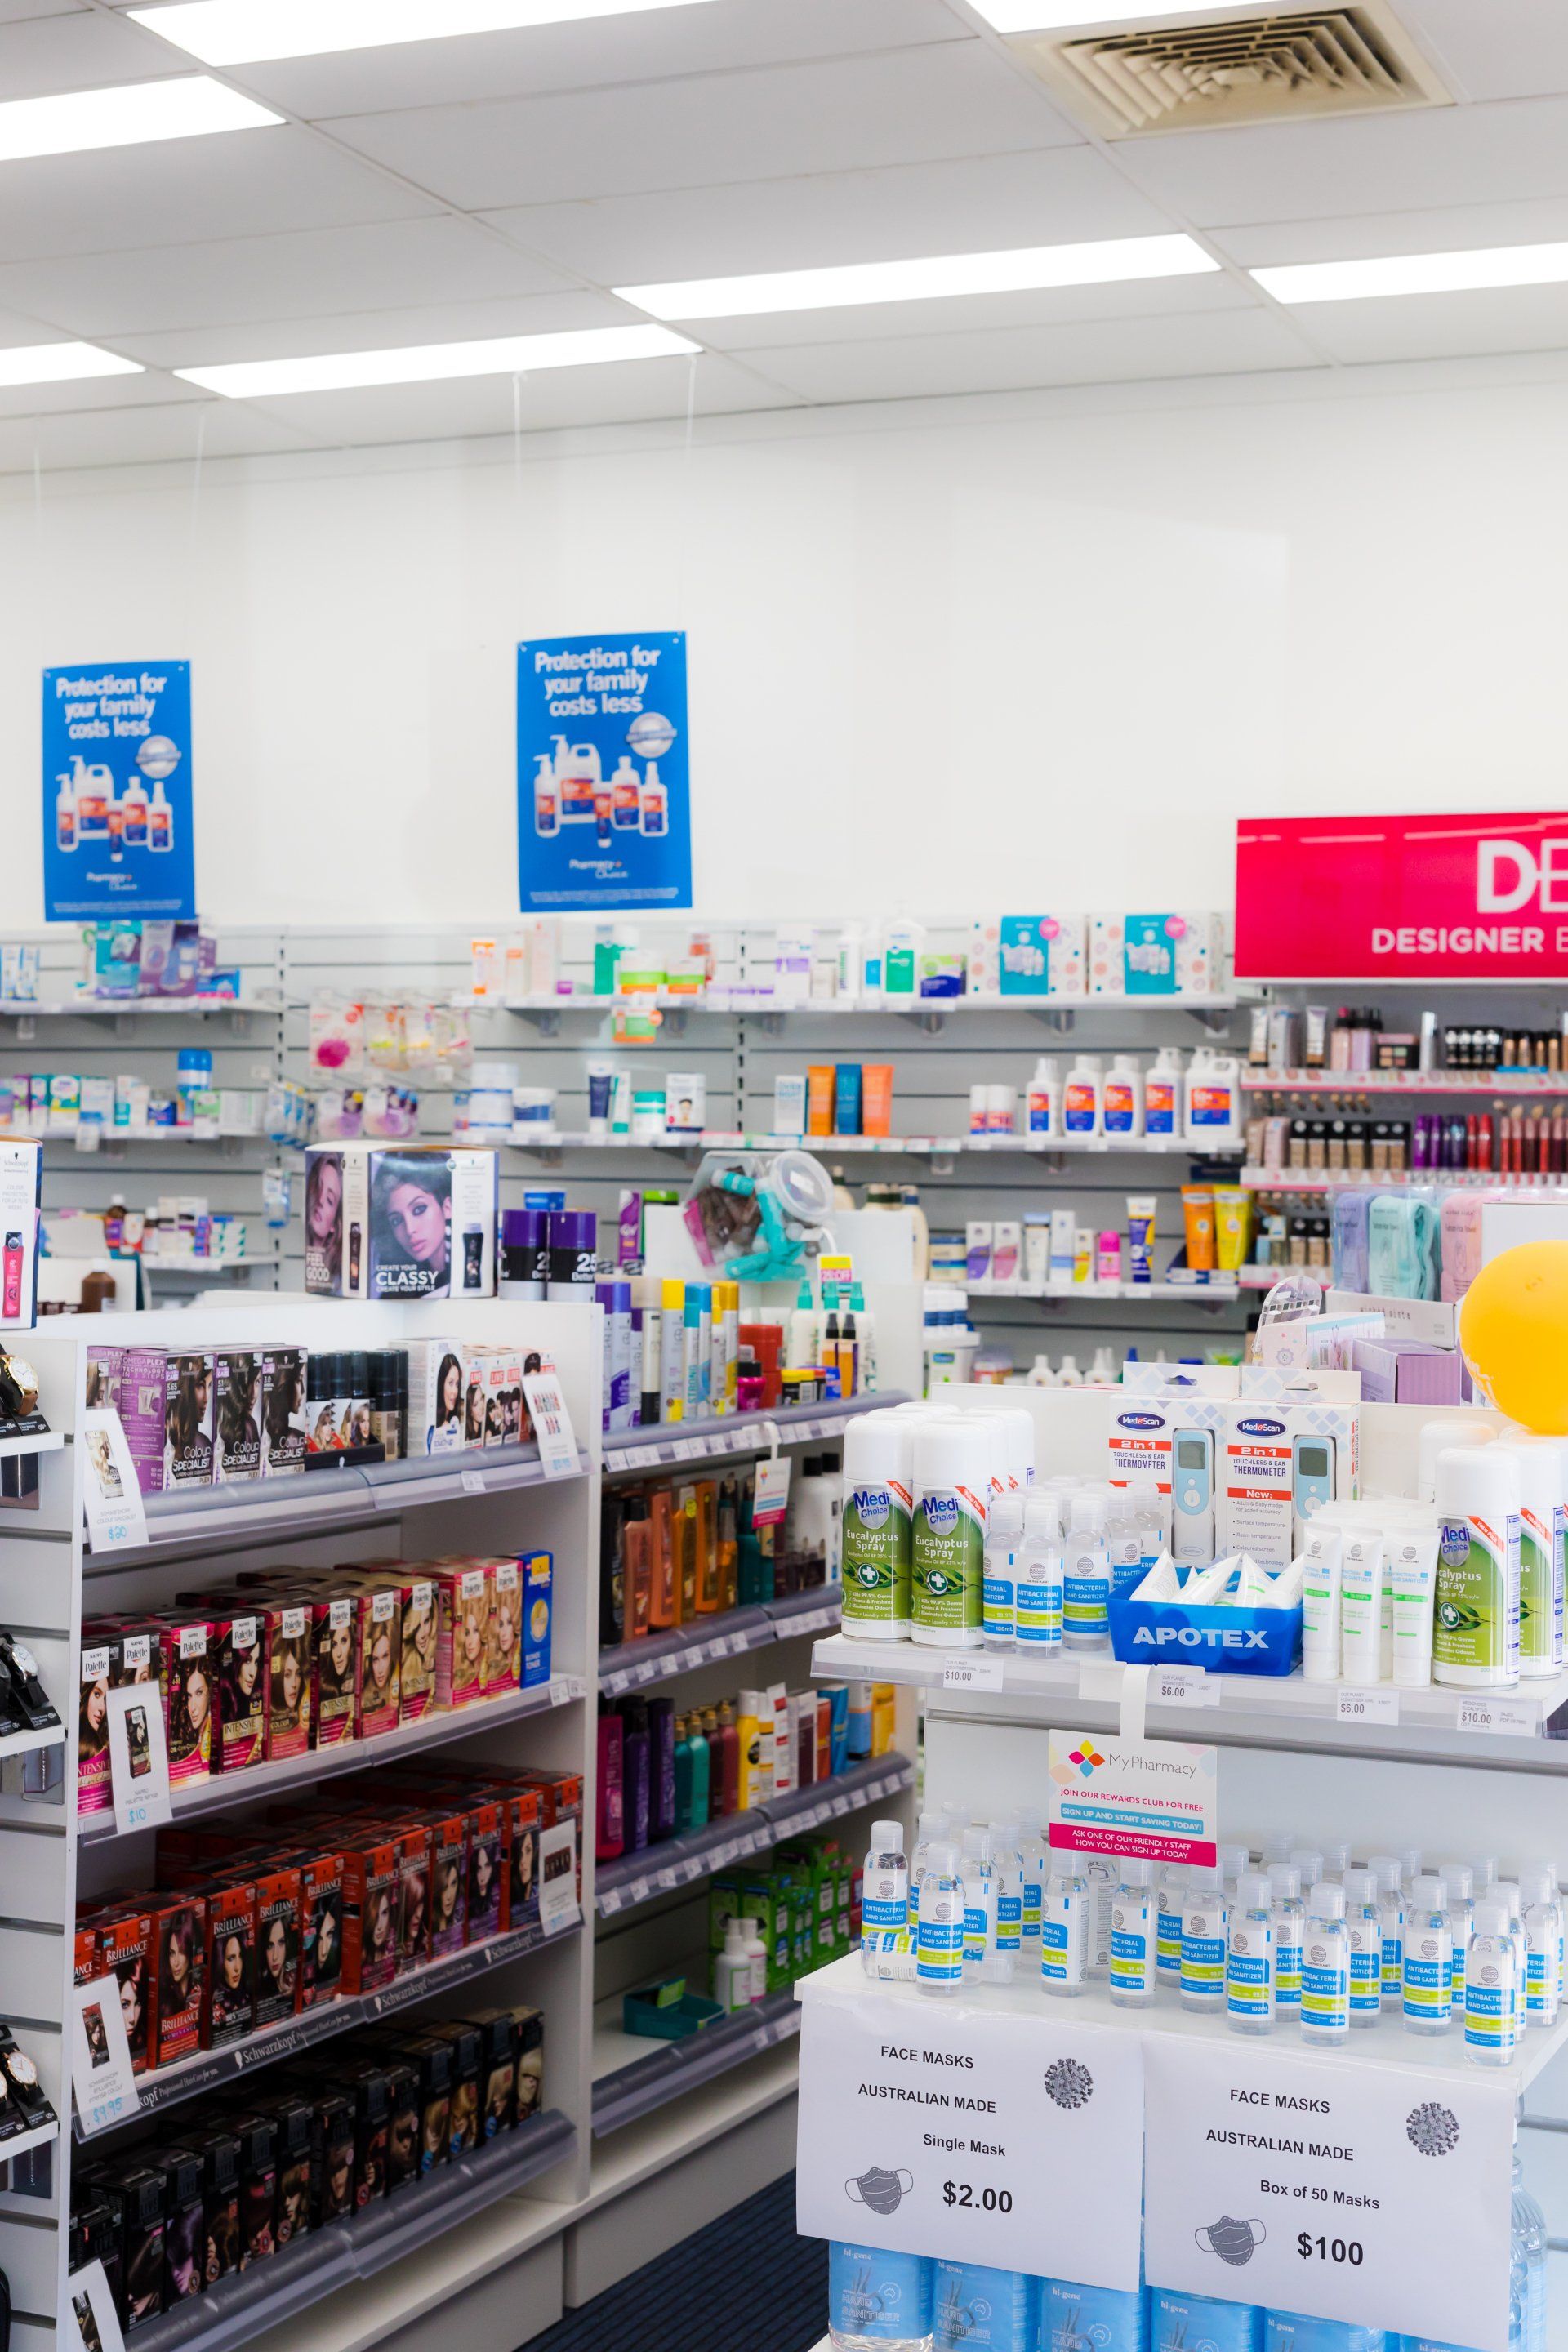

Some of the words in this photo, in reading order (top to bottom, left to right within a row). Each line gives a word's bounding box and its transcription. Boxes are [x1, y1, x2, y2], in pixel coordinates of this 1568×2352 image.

[534, 646, 627, 674] Protection
[630, 645, 661, 666] for
[56, 673, 137, 698] Protection
[140, 672, 167, 693] for
[544, 675, 582, 699] your
[586, 669, 648, 694] family
[65, 701, 97, 724] your
[100, 694, 155, 718] family
[550, 696, 597, 717] costs
[601, 693, 644, 714] less
[69, 719, 110, 739] costs
[114, 716, 151, 737] less
[1371, 927, 1545, 954] DESIGNER
[306, 1251, 327, 1267] FEEL
[306, 1267, 331, 1281] GOOD
[376, 1270, 439, 1286] CLASSY
[1122, 1416, 1160, 1426] MedeScan
[1242, 1423, 1281, 1432] MedeScan
[1121, 1440, 1132, 1449] 2
[1134, 1441, 1145, 1450] in
[1148, 1441, 1156, 1450] 1
[1241, 1447, 1252, 1455] 2
[1254, 1448, 1265, 1456] in
[1268, 1449, 1276, 1457] 1
[222, 1453, 260, 1468] SPECIALIST
[269, 1448, 305, 1461] SPECIALIST
[172, 1458, 211, 1472] SPECIALIST
[1114, 1459, 1165, 1470] THERMOMETER
[1234, 1465, 1286, 1477] THERMOMETER
[853, 1491, 890, 1510] Medi
[1246, 1490, 1273, 1499] New:
[861, 1507, 888, 1518] Choice
[922, 1496, 960, 1516] Medi
[929, 1513, 956, 1525] Choice
[1255, 1520, 1285, 1528] temperature
[108, 1526, 127, 1542] $20
[846, 1529, 899, 1542] Eucalyptus
[1251, 1532, 1281, 1540] temperature
[855, 1540, 885, 1553] Spray
[915, 1535, 969, 1548] Eucalyptus
[924, 1547, 954, 1560] Spray
[1442, 1544, 1468, 1554] Choice
[1439, 1579, 1466, 1593] Spray
[234, 1627, 254, 1641] Palette
[1132, 1626, 1269, 1649] APOTEX
[127, 1646, 149, 1660] Palette
[183, 1640, 203, 1653] Palette
[944, 1670, 972, 1681] $10.00
[1161, 1686, 1185, 1697] $6.00
[1340, 1703, 1365, 1713] $6.00
[1461, 1712, 1492, 1724] $10.00
[225, 1719, 256, 1734] INTENSIVE
[1061, 1788, 1079, 1797] JOIN
[1080, 1791, 1098, 1799] OUR
[1100, 1793, 1140, 1805] REWARDS
[1142, 1798, 1164, 1807] CLUB
[1165, 1801, 1183, 1810] FOR
[1184, 1803, 1204, 1812] FREE
[128, 1808, 147, 1824] $10
[1062, 1807, 1082, 1817] SIGN
[1083, 1810, 1094, 1818] UP
[1095, 1811, 1114, 1820] AND
[1115, 1814, 1140, 1823] START
[1141, 1816, 1171, 1827] SAVING
[1172, 1820, 1202, 1832] TODAY!
[1071, 1829, 1086, 1838] ASK
[1087, 1831, 1103, 1840] ONE
[1116, 1834, 1134, 1843] OUR
[1134, 1836, 1169, 1848] FRIENDLY
[1169, 1841, 1192, 1851] STAFF
[1076, 1839, 1096, 1848] HOW
[1096, 1841, 1113, 1850] YOU
[1114, 1843, 1130, 1852] CAN
[1131, 1845, 1149, 1854] SIGN
[1161, 1850, 1188, 1860] TODAY
[866, 1905, 906, 1914] ANTIBACTERIAL
[213, 1912, 255, 1935] BRILLIANCE
[921, 1927, 963, 1936] ANTIBACTERIAL
[1190, 1951, 1218, 1959] SANITIZER
[1234, 1971, 1262, 1980] SANITIZER
[1407, 1964, 1450, 1974] ANTIBACTERIAL
[382, 1977, 429, 2008] Schwarzkopf
[1310, 1983, 1339, 1991] SANITIZER
[161, 2009, 199, 2033] BRILLIANCE
[243, 2032, 296, 2064] Schwarzkopf
[881, 2046, 919, 2062] FACE
[923, 2051, 974, 2069] MASKS
[858, 2083, 950, 2107] AUSTRALIAN
[954, 2096, 996, 2114] MADE
[1230, 2089, 1270, 2106] FACE
[1275, 2095, 1330, 2114] MASKS
[92, 2097, 123, 2124] $9.95
[923, 2133, 965, 2152] Single
[970, 2140, 1006, 2157] Mask
[1206, 2129, 1303, 2154] AUSTRALIAN
[1308, 2143, 1354, 2161] MADE
[942, 2180, 1013, 2213] $2.00
[1260, 2180, 1289, 2196] Box
[1293, 2186, 1307, 2198] of
[1312, 2189, 1328, 2202] 50
[1333, 2190, 1380, 2209] Masks
[1298, 2231, 1364, 2266] $100
[1052, 2287, 1080, 2301] hi-gene
[1160, 2301, 1189, 2314] hi-gene
[841, 2309, 901, 2323] SANITISER
[938, 2319, 991, 2340] SANITISER
